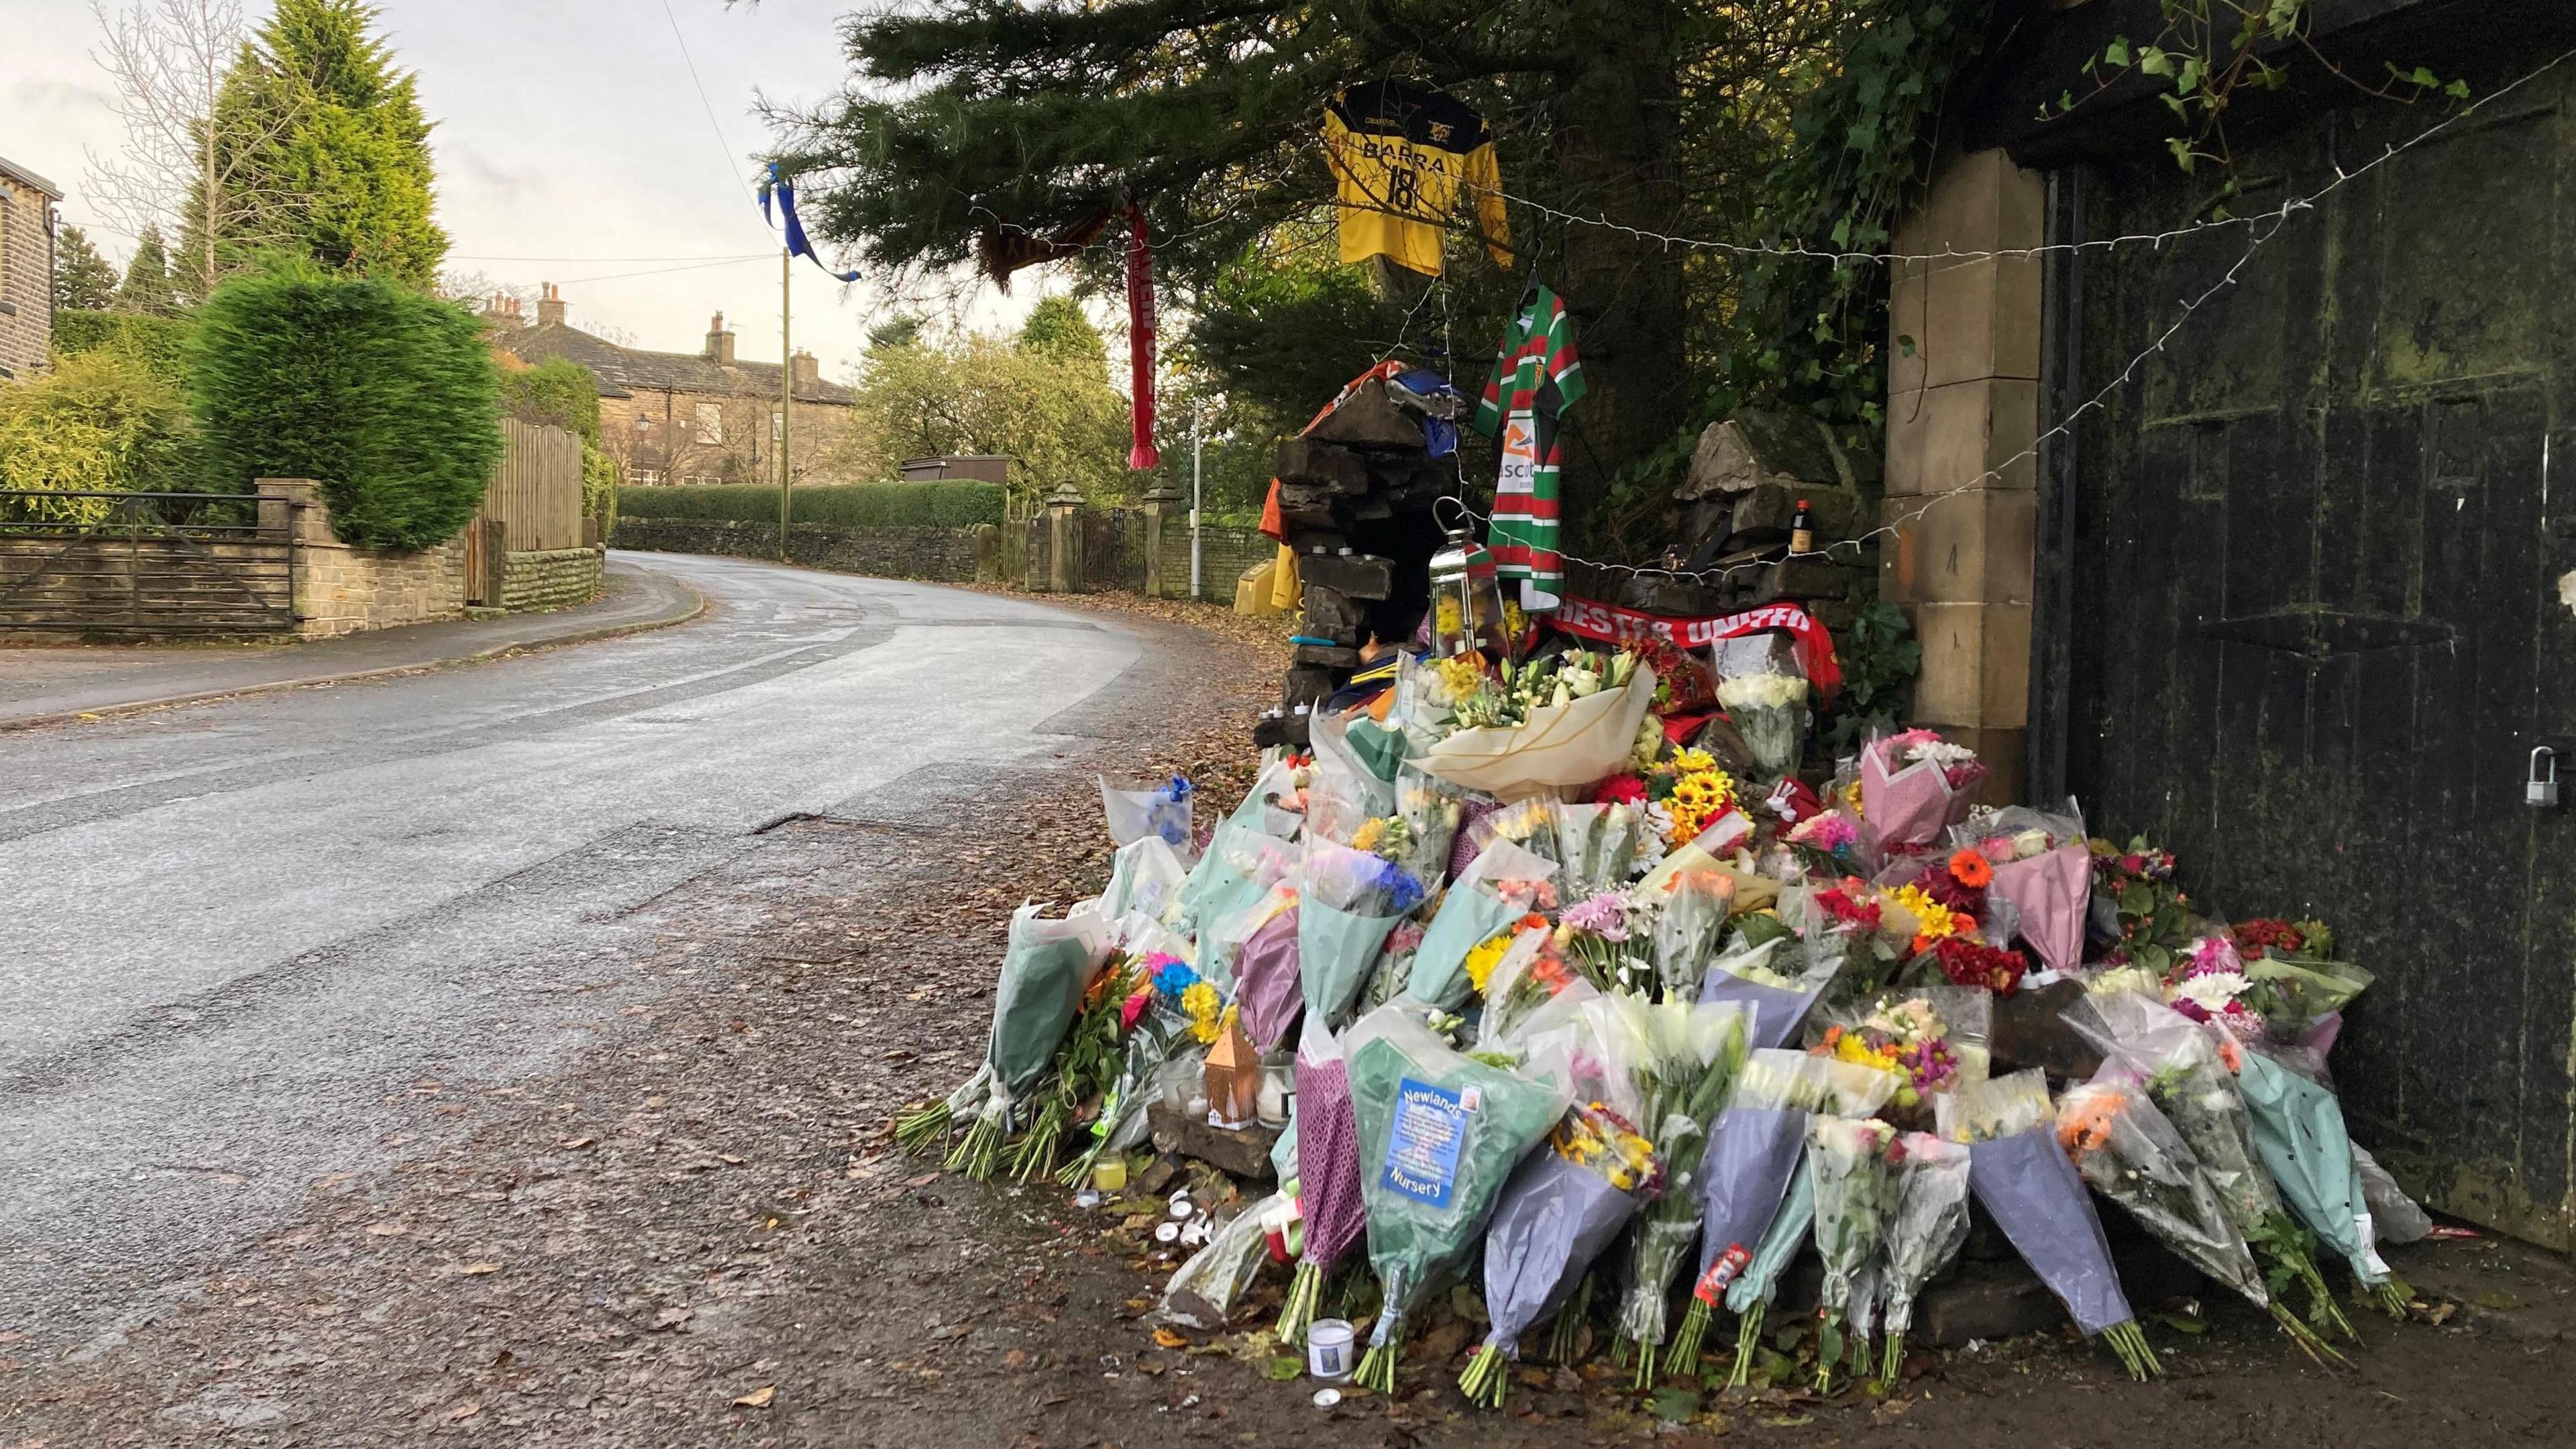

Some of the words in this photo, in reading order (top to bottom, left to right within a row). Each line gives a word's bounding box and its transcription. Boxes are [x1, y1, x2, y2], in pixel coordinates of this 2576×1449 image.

[1363, 142, 1445, 173] BARRA
[1388, 165, 1416, 210] 18
[1687, 607, 1811, 643] UNITED
[1403, 1089, 1462, 1120] Newlands
[1390, 1166, 1442, 1198] Nursery
